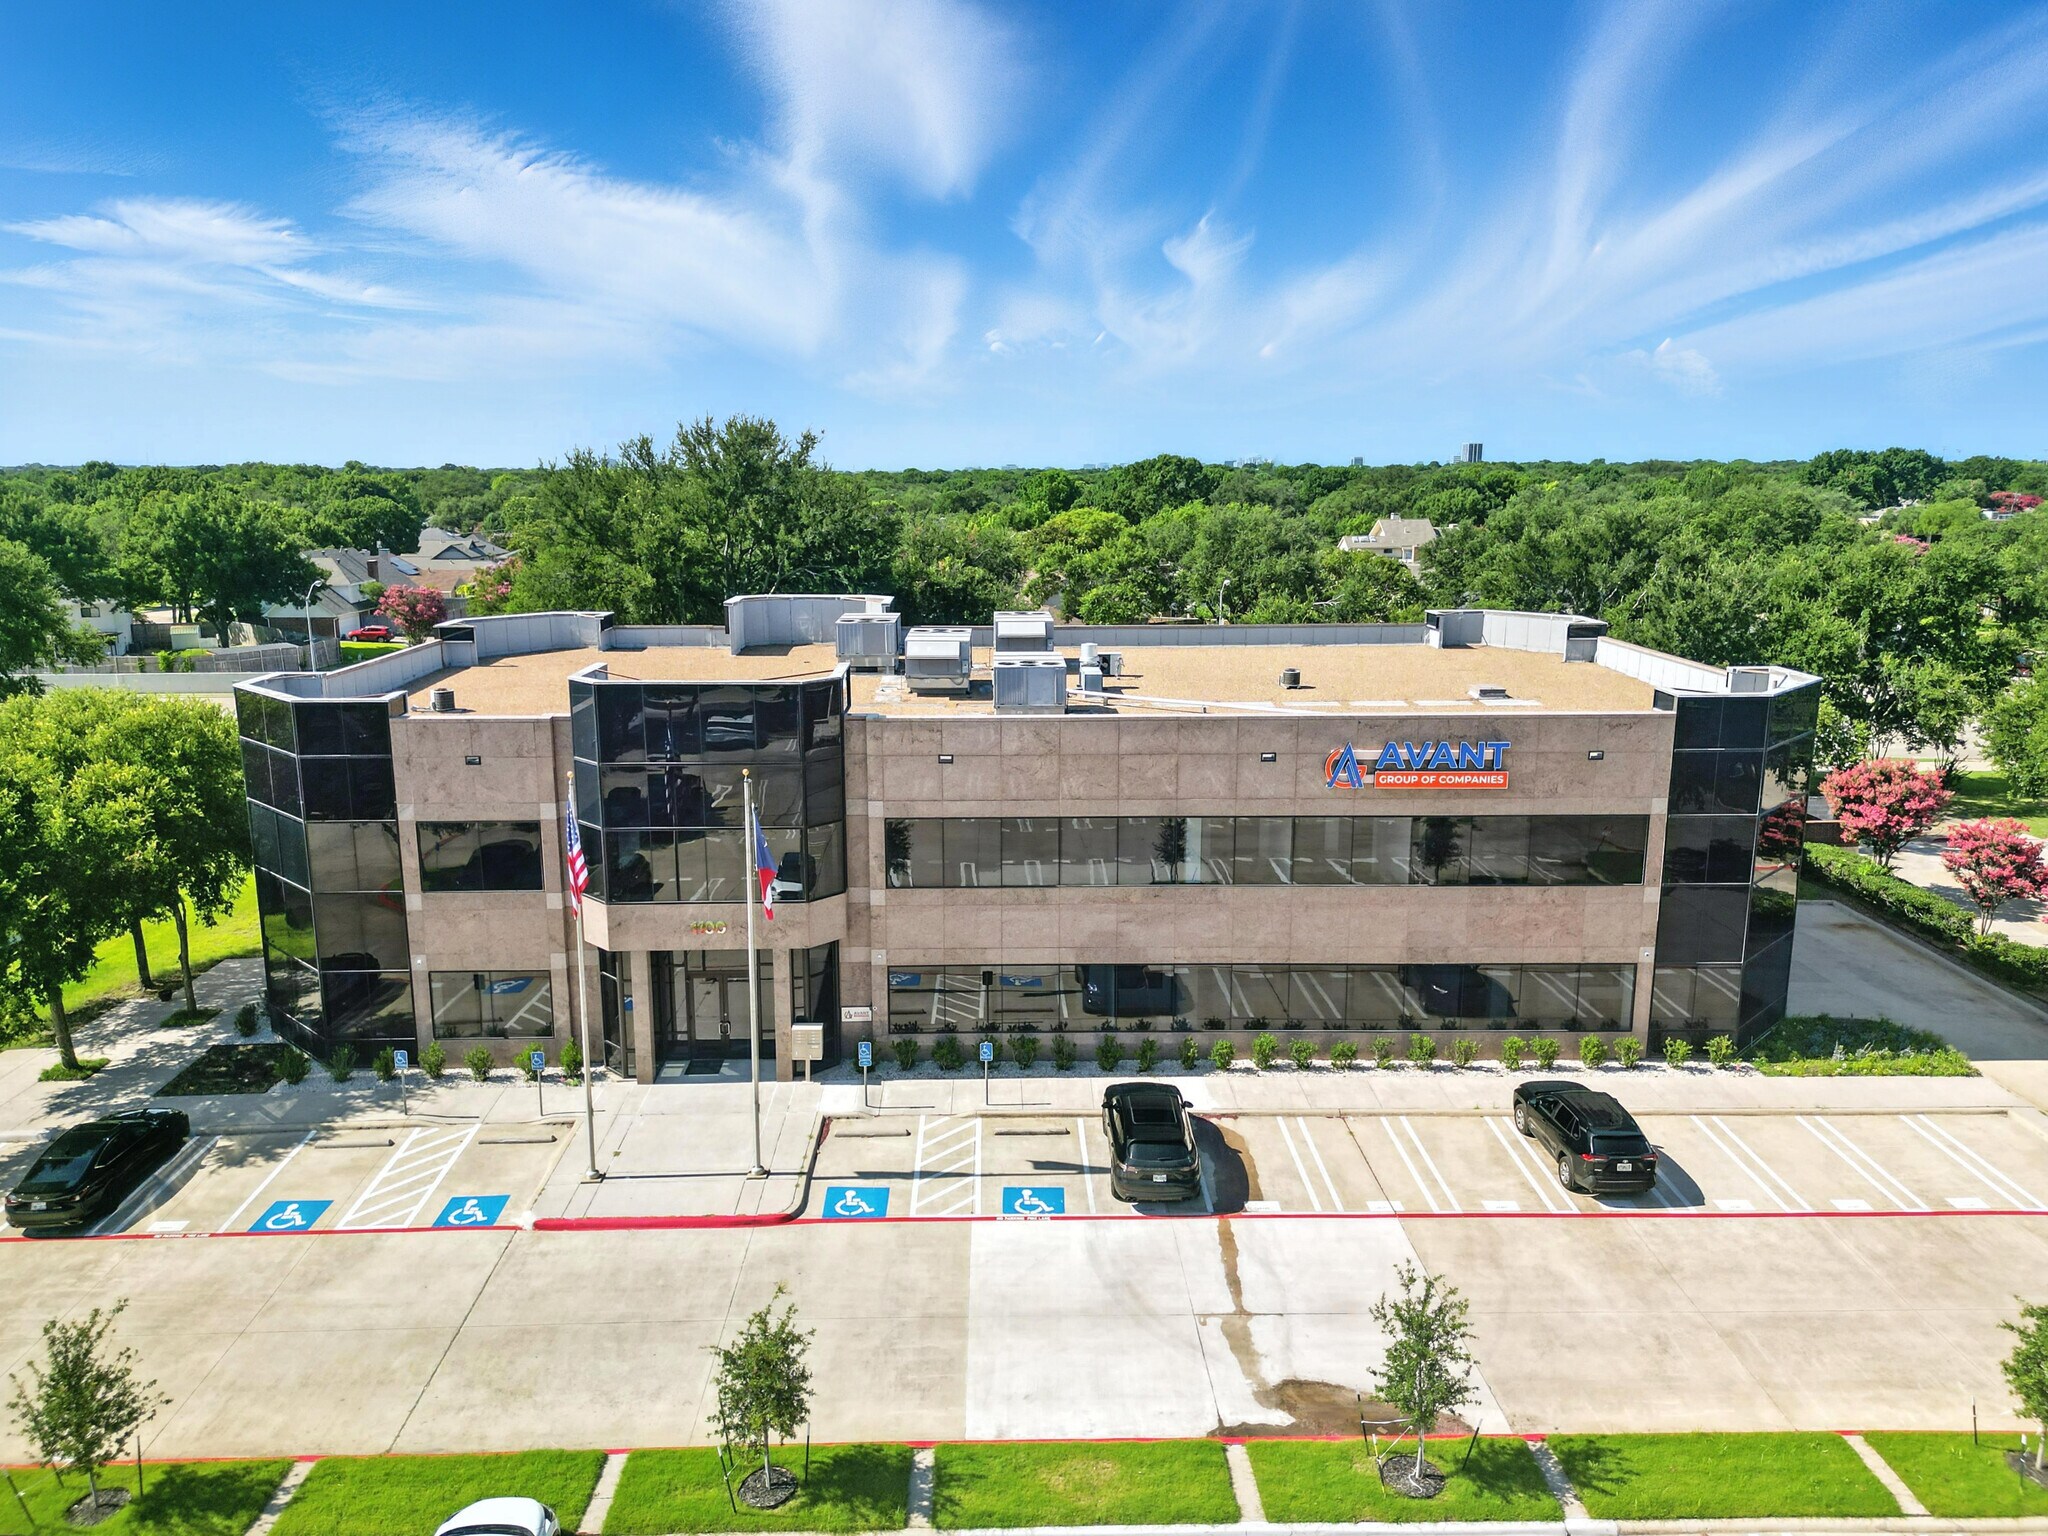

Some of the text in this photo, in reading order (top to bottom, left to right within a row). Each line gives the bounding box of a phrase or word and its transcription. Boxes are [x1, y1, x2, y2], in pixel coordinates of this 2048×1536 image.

[1376, 742, 1511, 768] AVANT
[1379, 775, 1504, 784] GROUP OF COMPANIES
